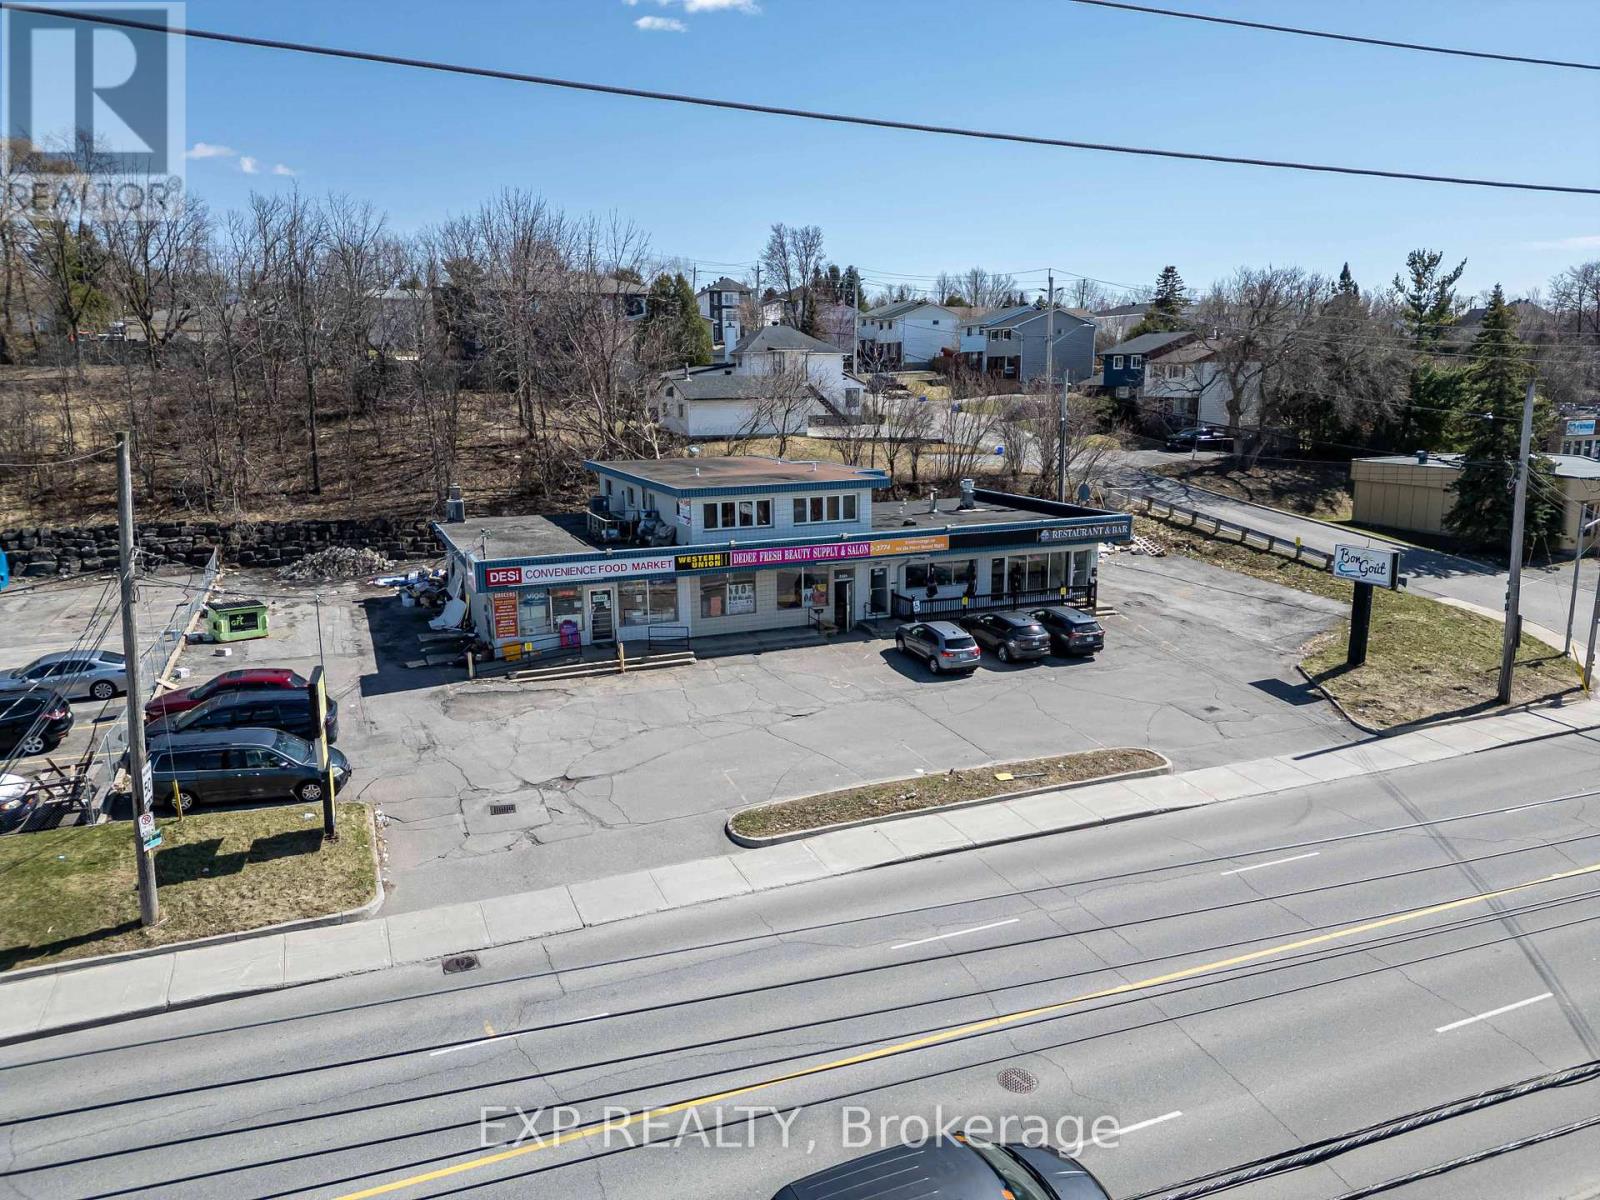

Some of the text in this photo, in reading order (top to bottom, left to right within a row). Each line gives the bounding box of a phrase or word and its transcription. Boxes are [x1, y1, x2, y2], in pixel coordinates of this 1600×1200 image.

[1052, 525, 1128, 538] RESTAURANT & BAR
[678, 554, 721, 563] WESTERN
[733, 544, 869, 564] DEDEE FRESH BEAUTY SUPPLY & SALON
[1341, 548, 1361, 564] Bon
[525, 565, 596, 579] CONVENIENCE
[598, 563, 628, 574] FOOD
[631, 560, 672, 571] MARKET
[691, 560, 721, 569] UNION
